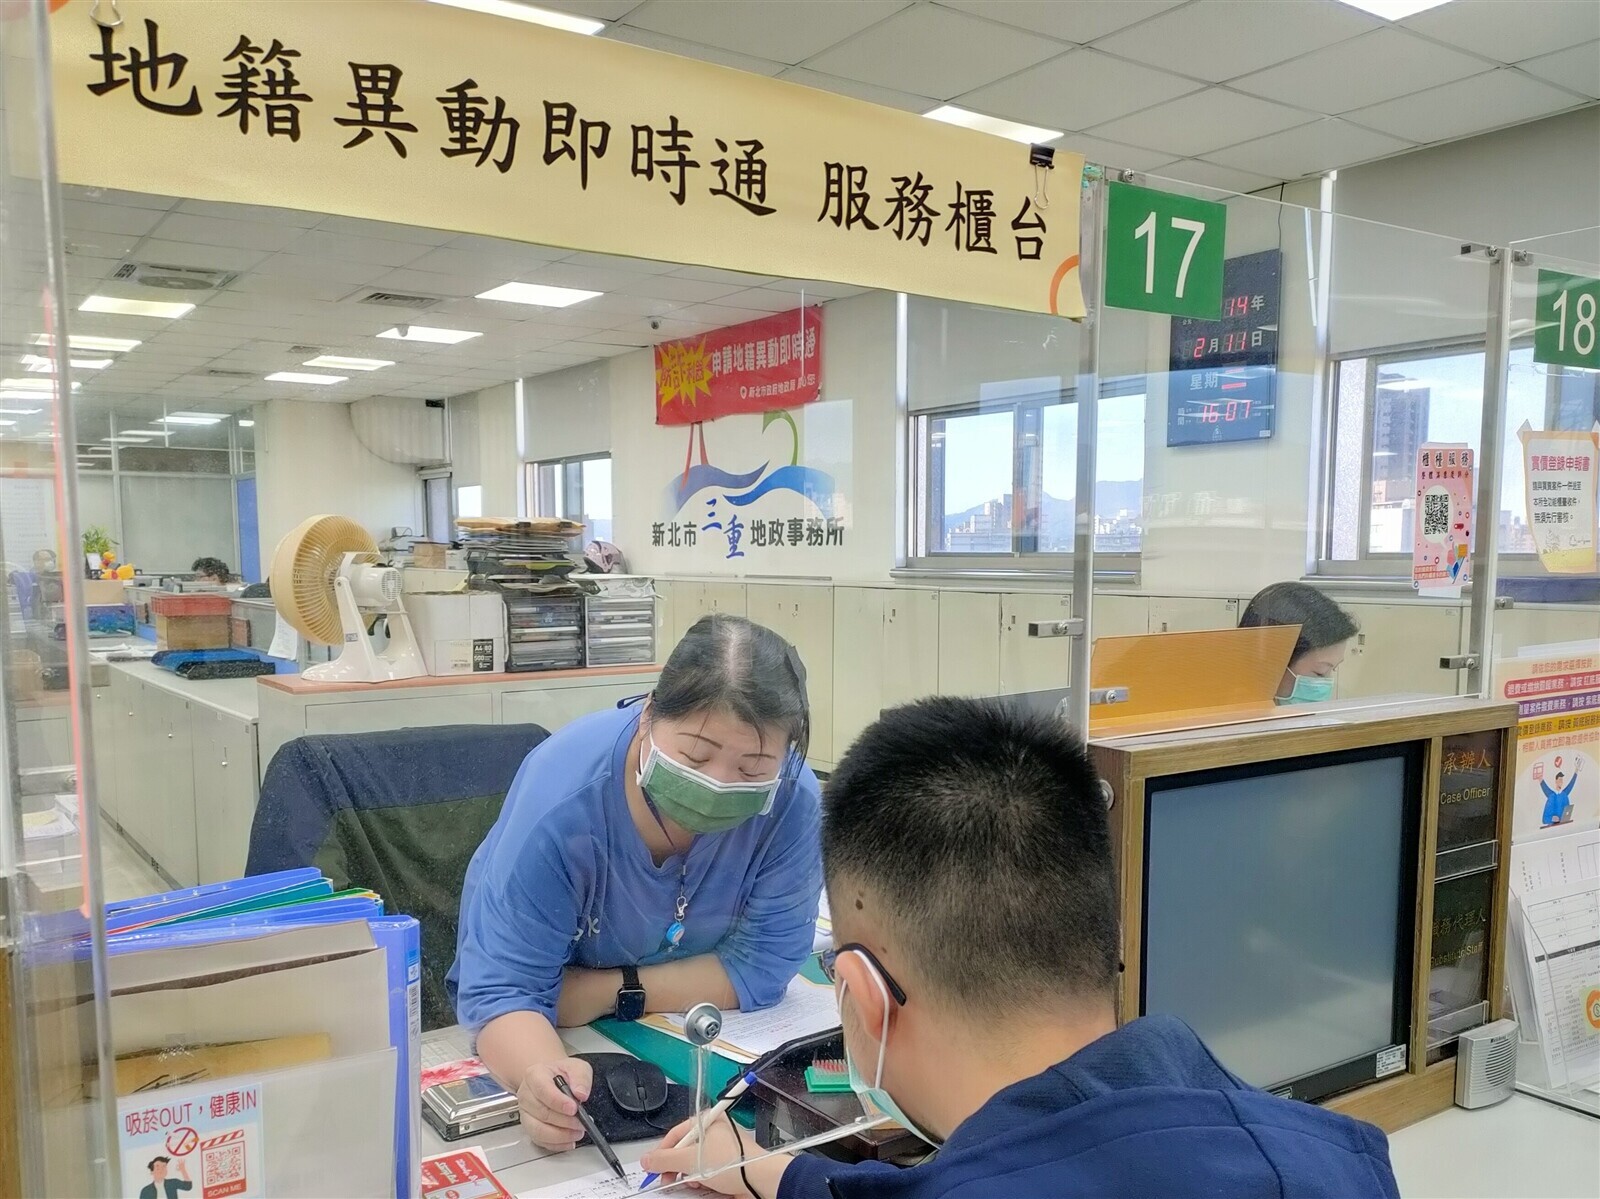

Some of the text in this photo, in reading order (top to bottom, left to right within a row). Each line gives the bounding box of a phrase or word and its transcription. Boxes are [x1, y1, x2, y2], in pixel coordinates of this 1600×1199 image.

[87, 19, 1048, 261] 地籍異動即時通 服務櫃台
[1134, 211, 1206, 298] 17
[1552, 289, 1596, 355] 18
[712, 327, 816, 378] 申請地籍異動即時通
[749, 380, 796, 398] 新北市政府地政局
[1531, 455, 1591, 472] 實價登錄申報書
[1444, 749, 1492, 776] 承辦人
[1440, 786, 1491, 805] Case Officer
[207, 1183, 242, 1198] SCAN ME
